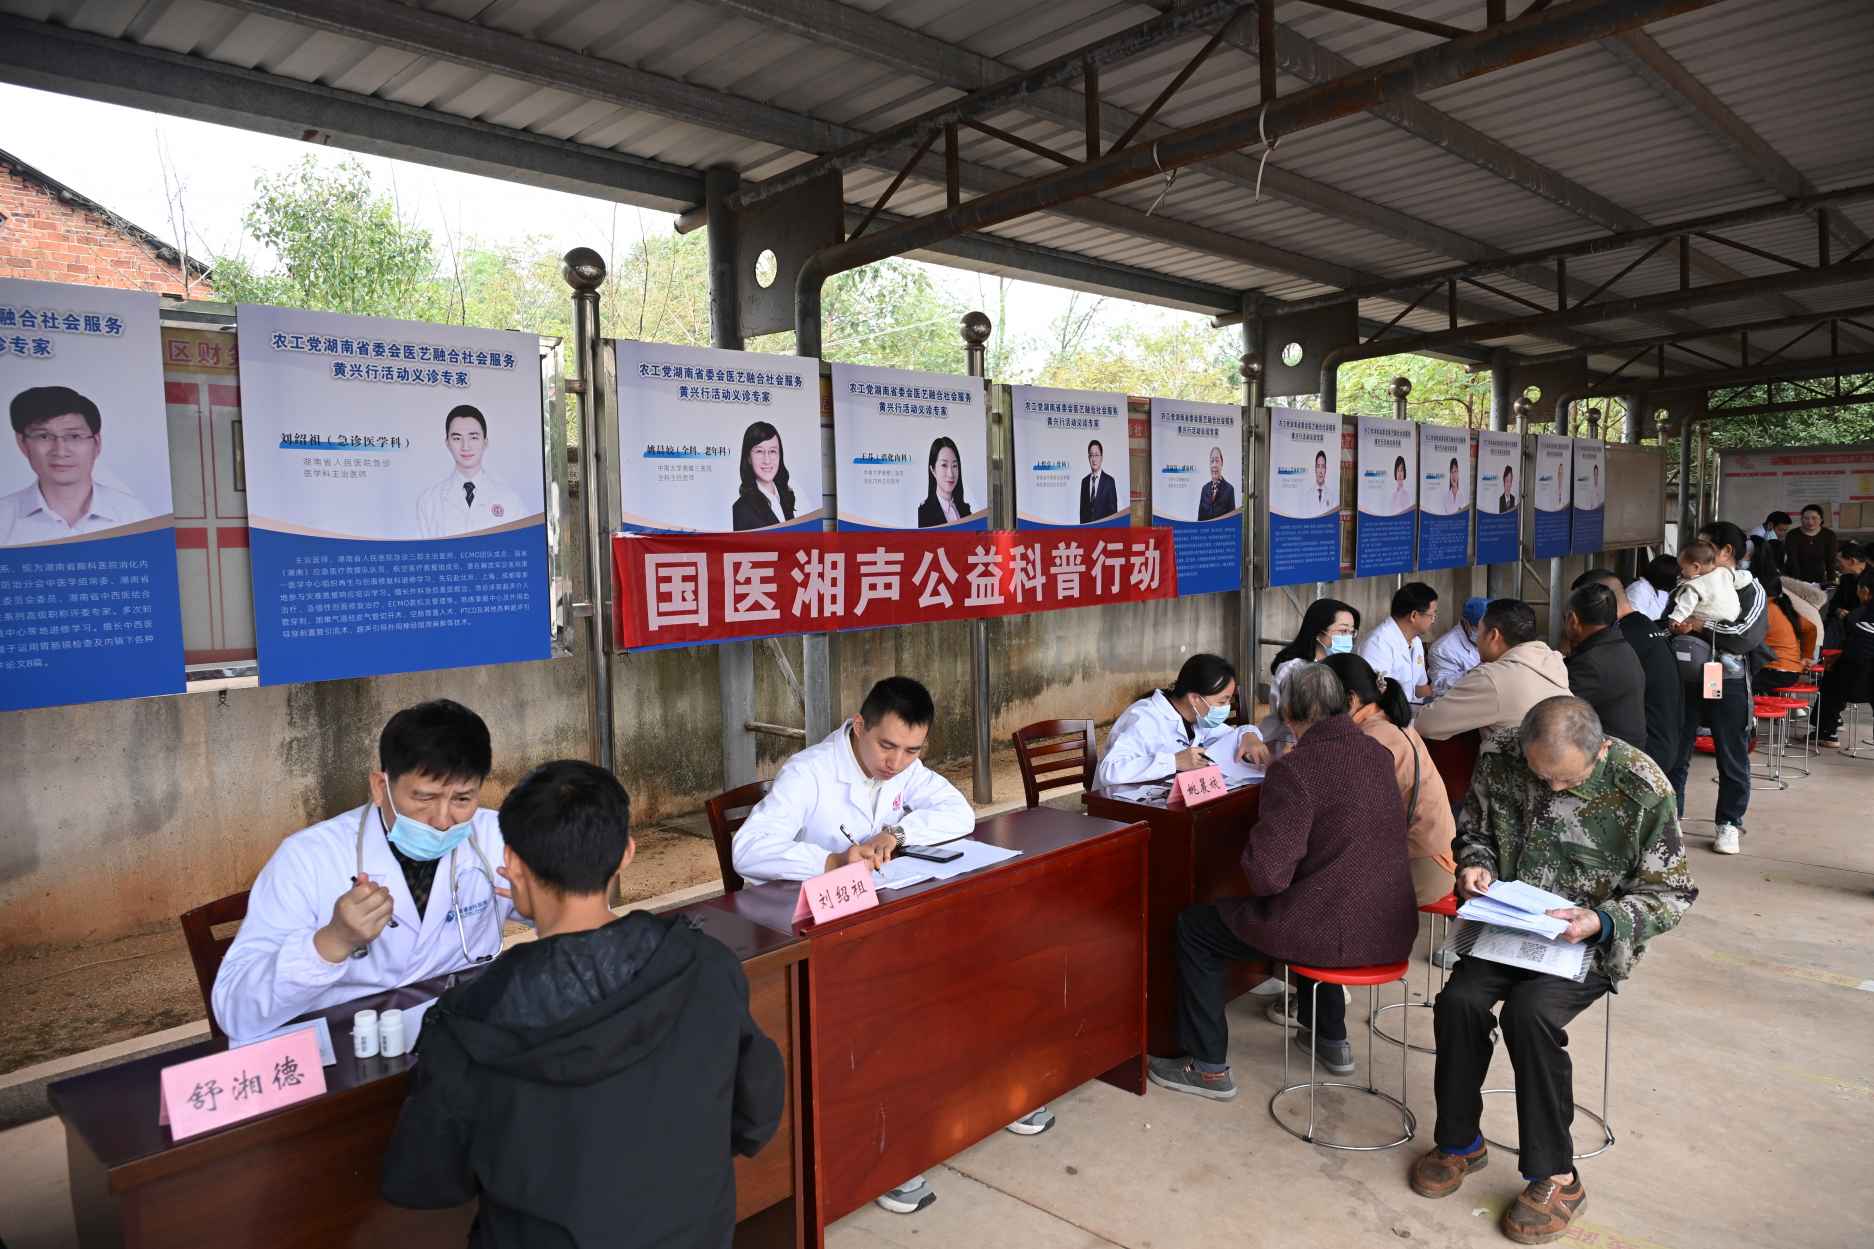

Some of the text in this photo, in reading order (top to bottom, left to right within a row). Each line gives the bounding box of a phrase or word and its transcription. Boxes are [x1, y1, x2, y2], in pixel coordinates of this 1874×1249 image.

[272, 334, 516, 369] 农工党湖南省委会医艺融合社会服务
[333, 362, 469, 387] 黄兴行活动义诊专家
[639, 363, 803, 388] 农工党湖南省委会医艺融合社会服务
[679, 386, 771, 403] 黄兴行活动义诊专家
[644, 537, 1162, 632] 国医湘声公益科普行动
[818, 879, 869, 910] 刘绍祖
[186, 1055, 305, 1114] 舒湘德
